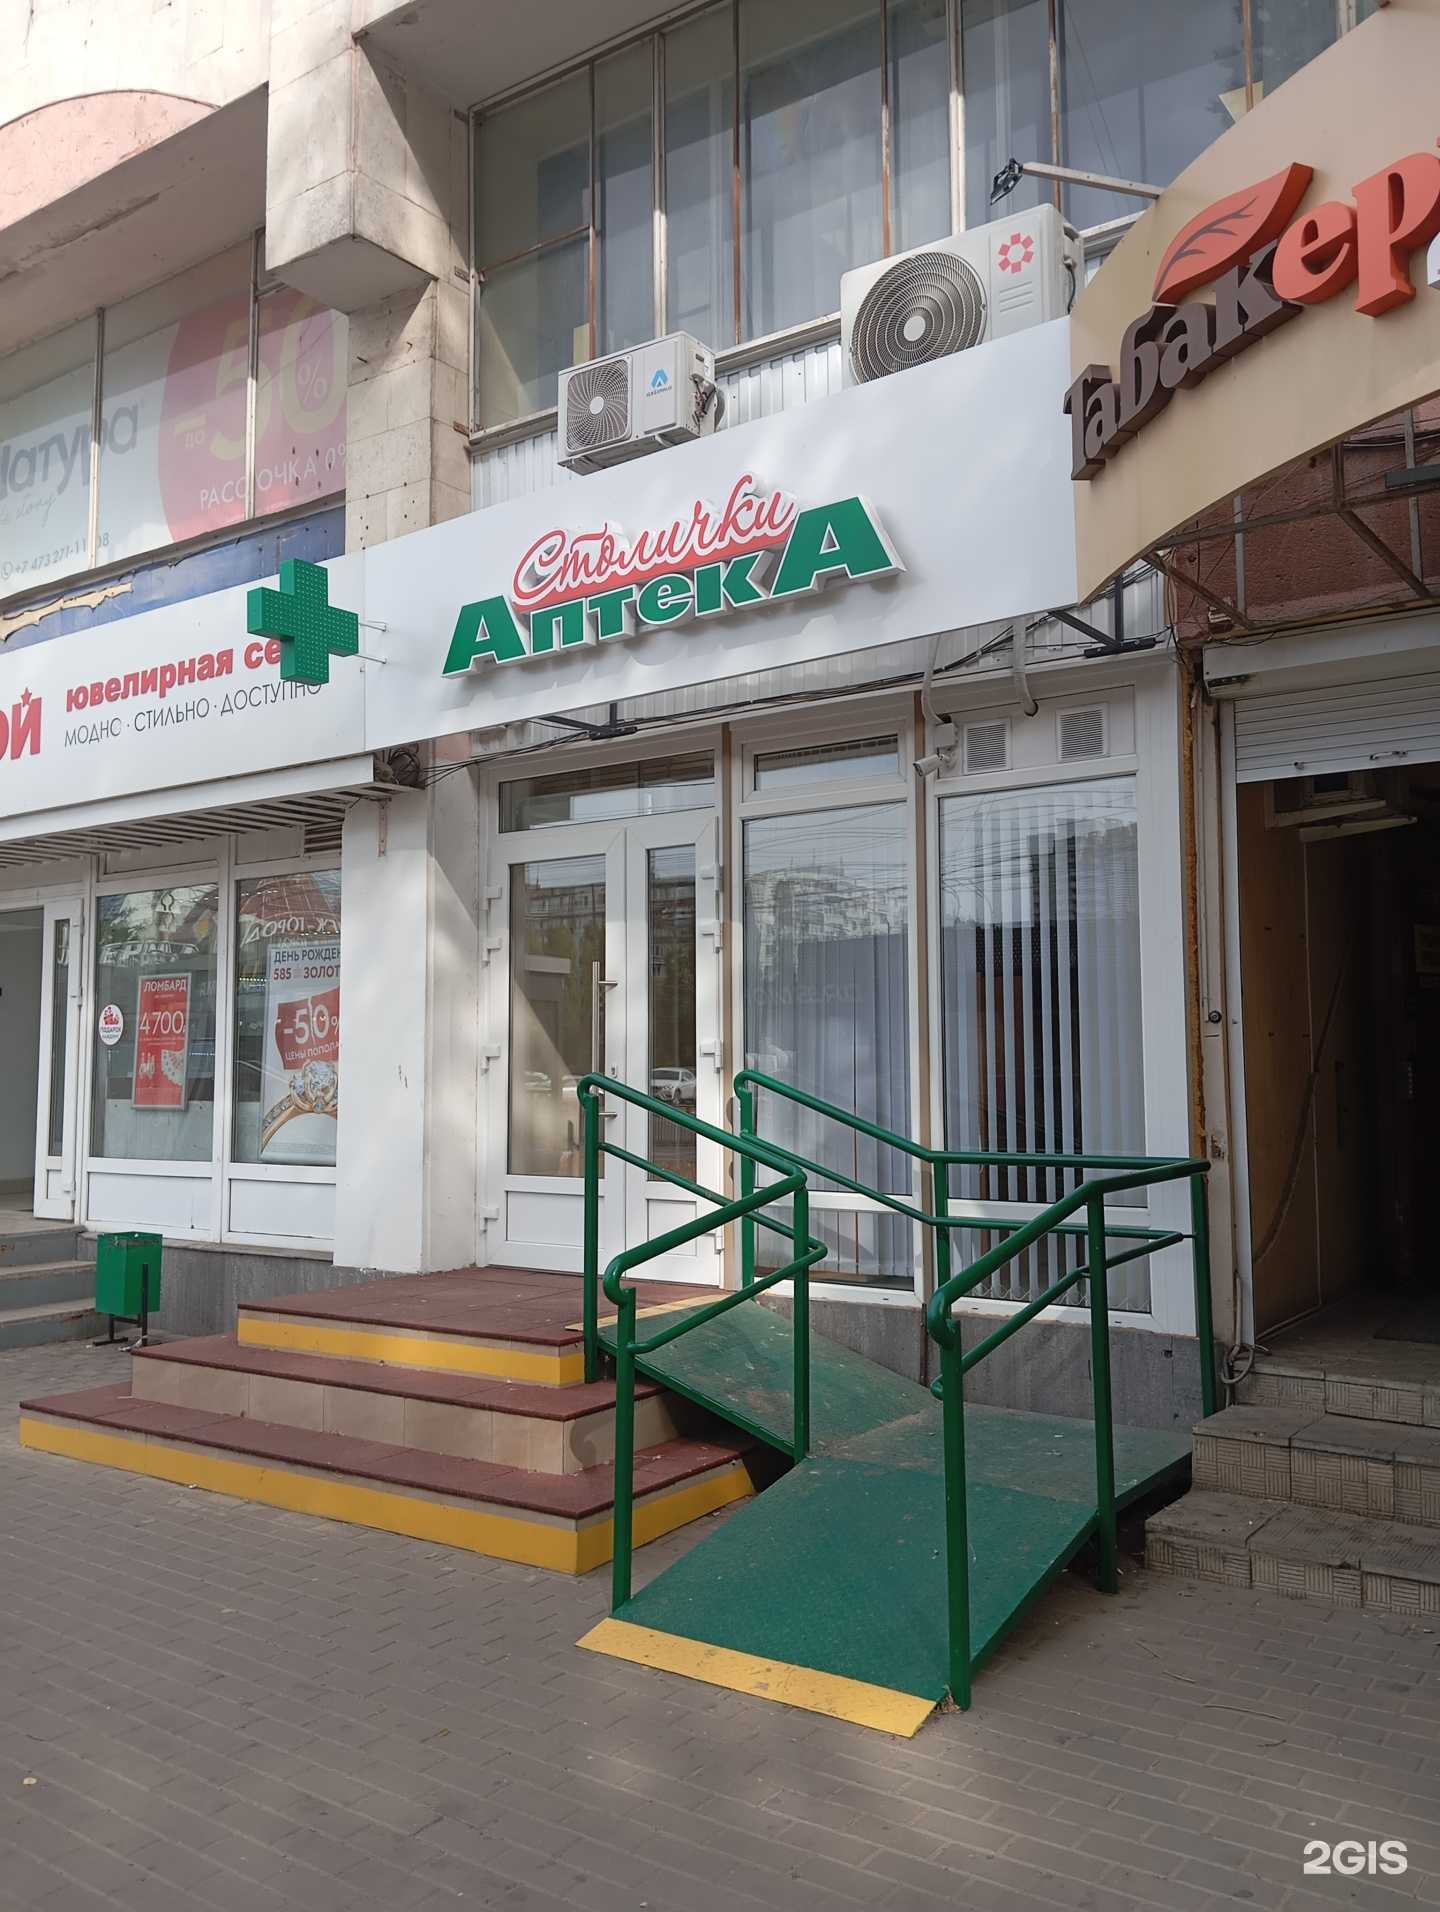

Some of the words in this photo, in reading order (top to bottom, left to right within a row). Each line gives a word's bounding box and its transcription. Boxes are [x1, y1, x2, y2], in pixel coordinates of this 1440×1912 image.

[200, 458, 317, 511] РАССОЧКА
[512, 473, 796, 603] Столички
[66, 648, 233, 712] ювелирная
[134, 697, 210, 732] СТИЛЬНО
[273, 967, 292, 980] 585
[274, 951, 300, 964] ДЕНЬ
[143, 979, 187, 993] ЛОМБАРД
